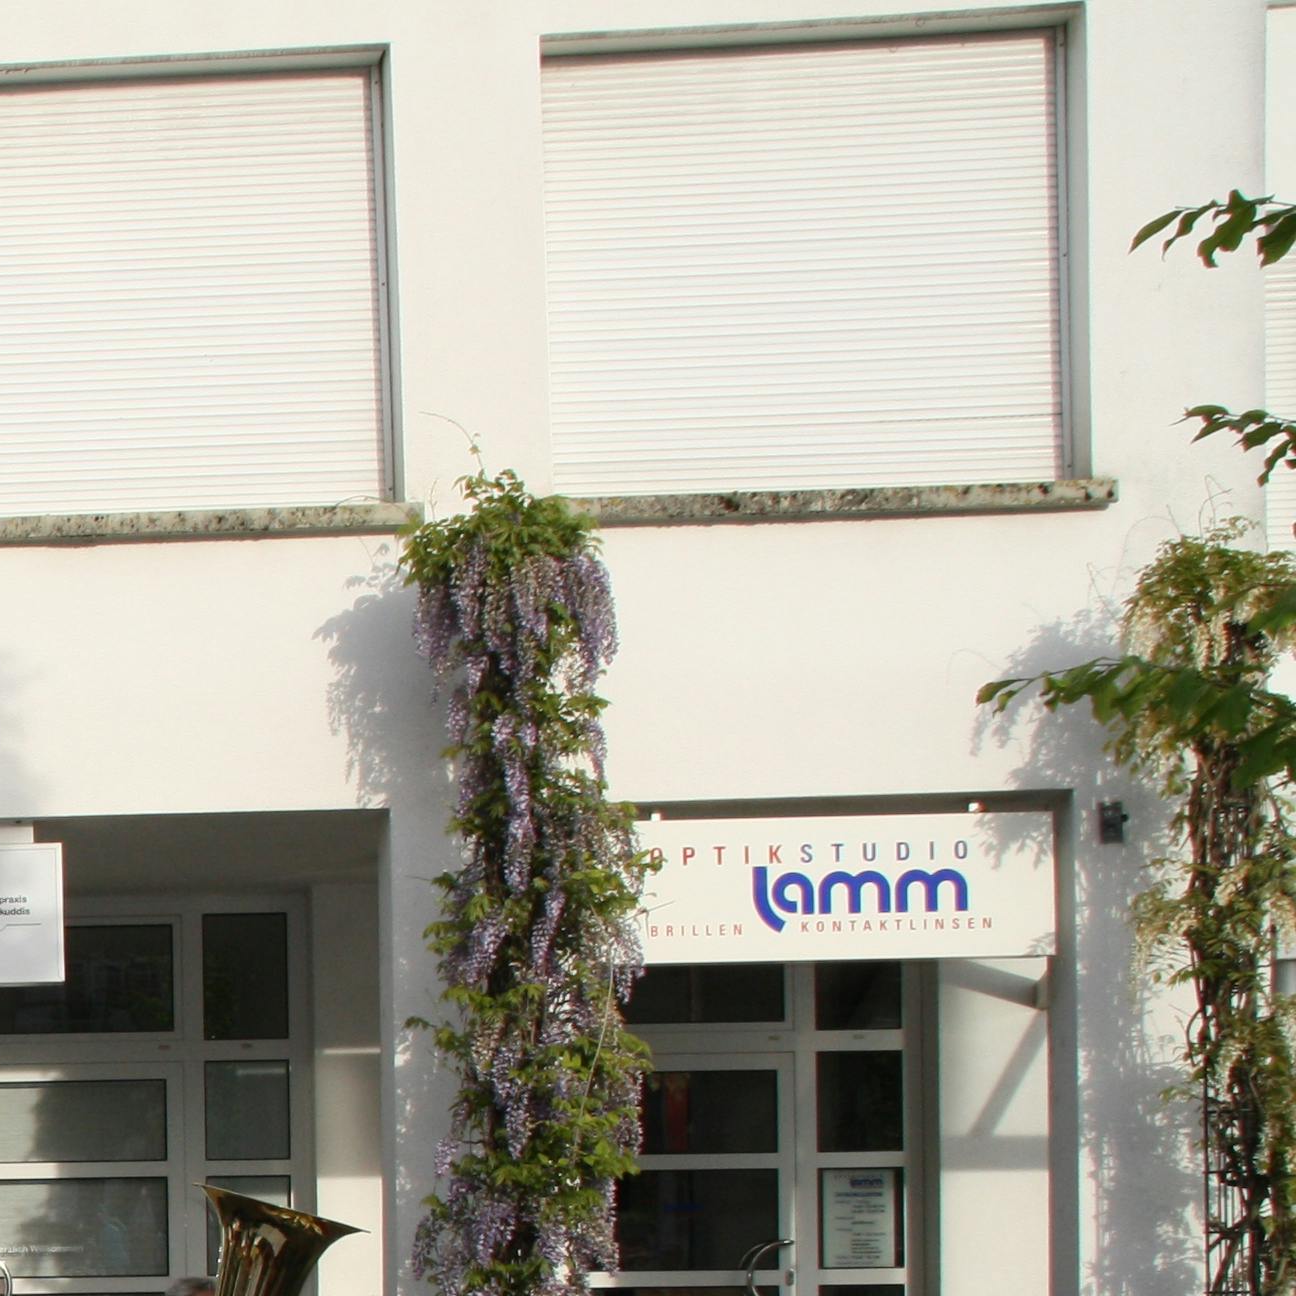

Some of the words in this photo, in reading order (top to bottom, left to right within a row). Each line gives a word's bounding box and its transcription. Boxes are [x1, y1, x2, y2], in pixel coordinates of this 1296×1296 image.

[752, 866, 969, 933] lamm
[650, 924, 743, 938] BRILLEN
[800, 917, 993, 933] KONTAKTLINSEN
